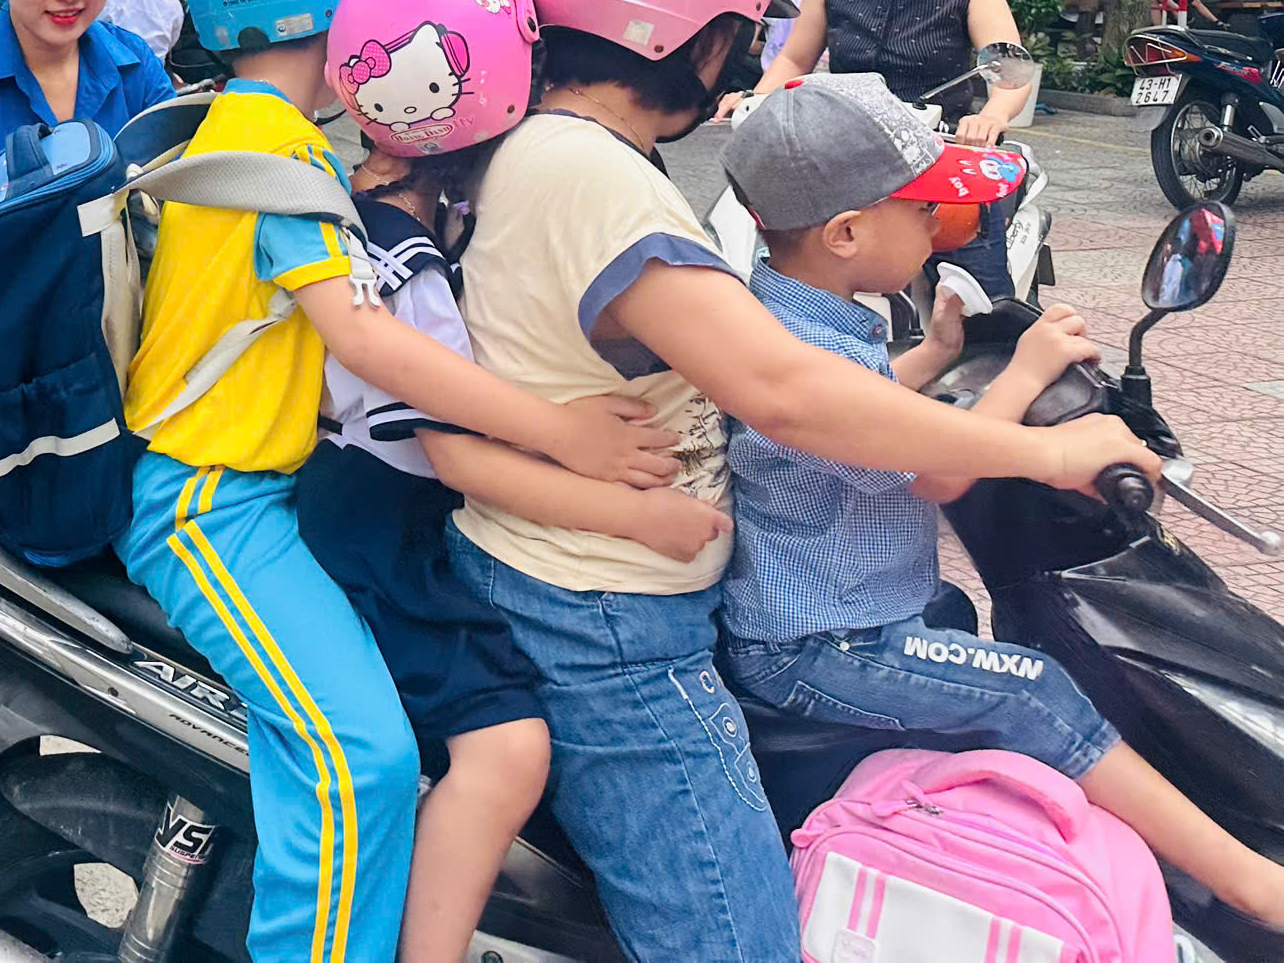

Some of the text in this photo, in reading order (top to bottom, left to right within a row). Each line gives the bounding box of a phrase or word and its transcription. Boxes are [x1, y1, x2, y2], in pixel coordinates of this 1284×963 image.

[903, 637, 1044, 681] NXW.COM
[134, 661, 230, 711] AIR
[169, 713, 249, 756] ADVANCE
